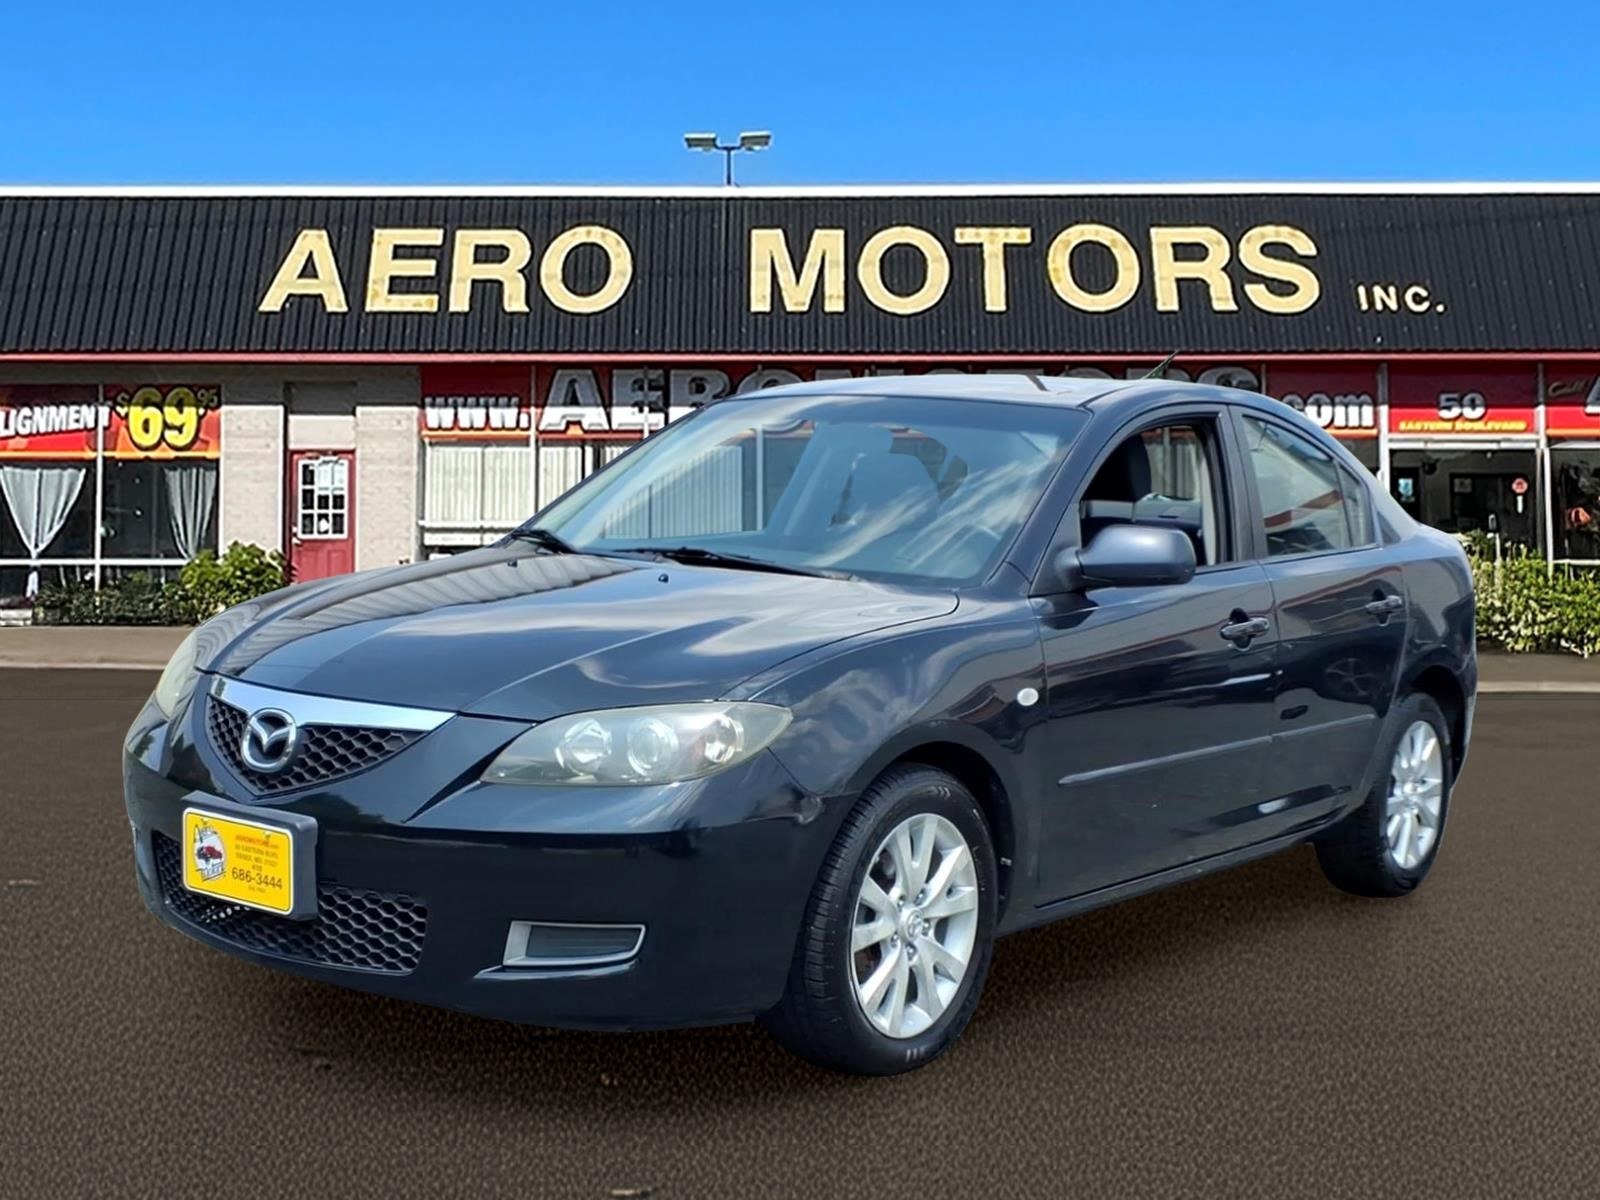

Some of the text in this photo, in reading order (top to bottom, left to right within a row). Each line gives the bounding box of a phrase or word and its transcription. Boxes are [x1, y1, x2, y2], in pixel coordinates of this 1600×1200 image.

[259, 223, 1445, 316] AERO MOTORS INC.
[1437, 392, 1486, 420] 50
[231, 867, 282, 890] 686-3444
